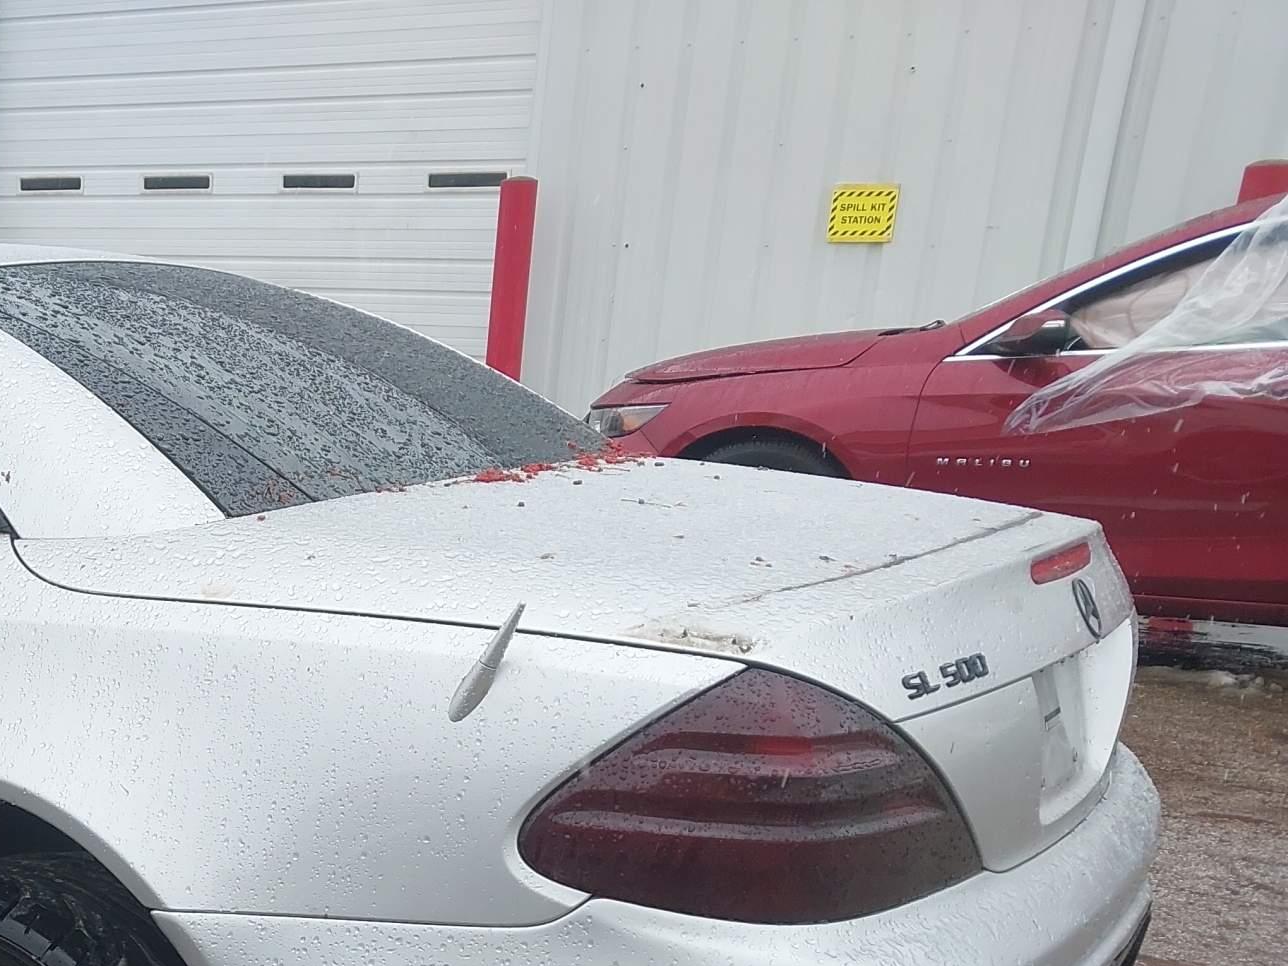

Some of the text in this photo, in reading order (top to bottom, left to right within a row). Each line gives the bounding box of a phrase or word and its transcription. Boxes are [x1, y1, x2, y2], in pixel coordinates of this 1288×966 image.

[839, 202, 887, 212] SPILL KIT
[840, 215, 881, 225] STATION
[936, 457, 1030, 468] MALIBU
[901, 652, 990, 701] SL 500
